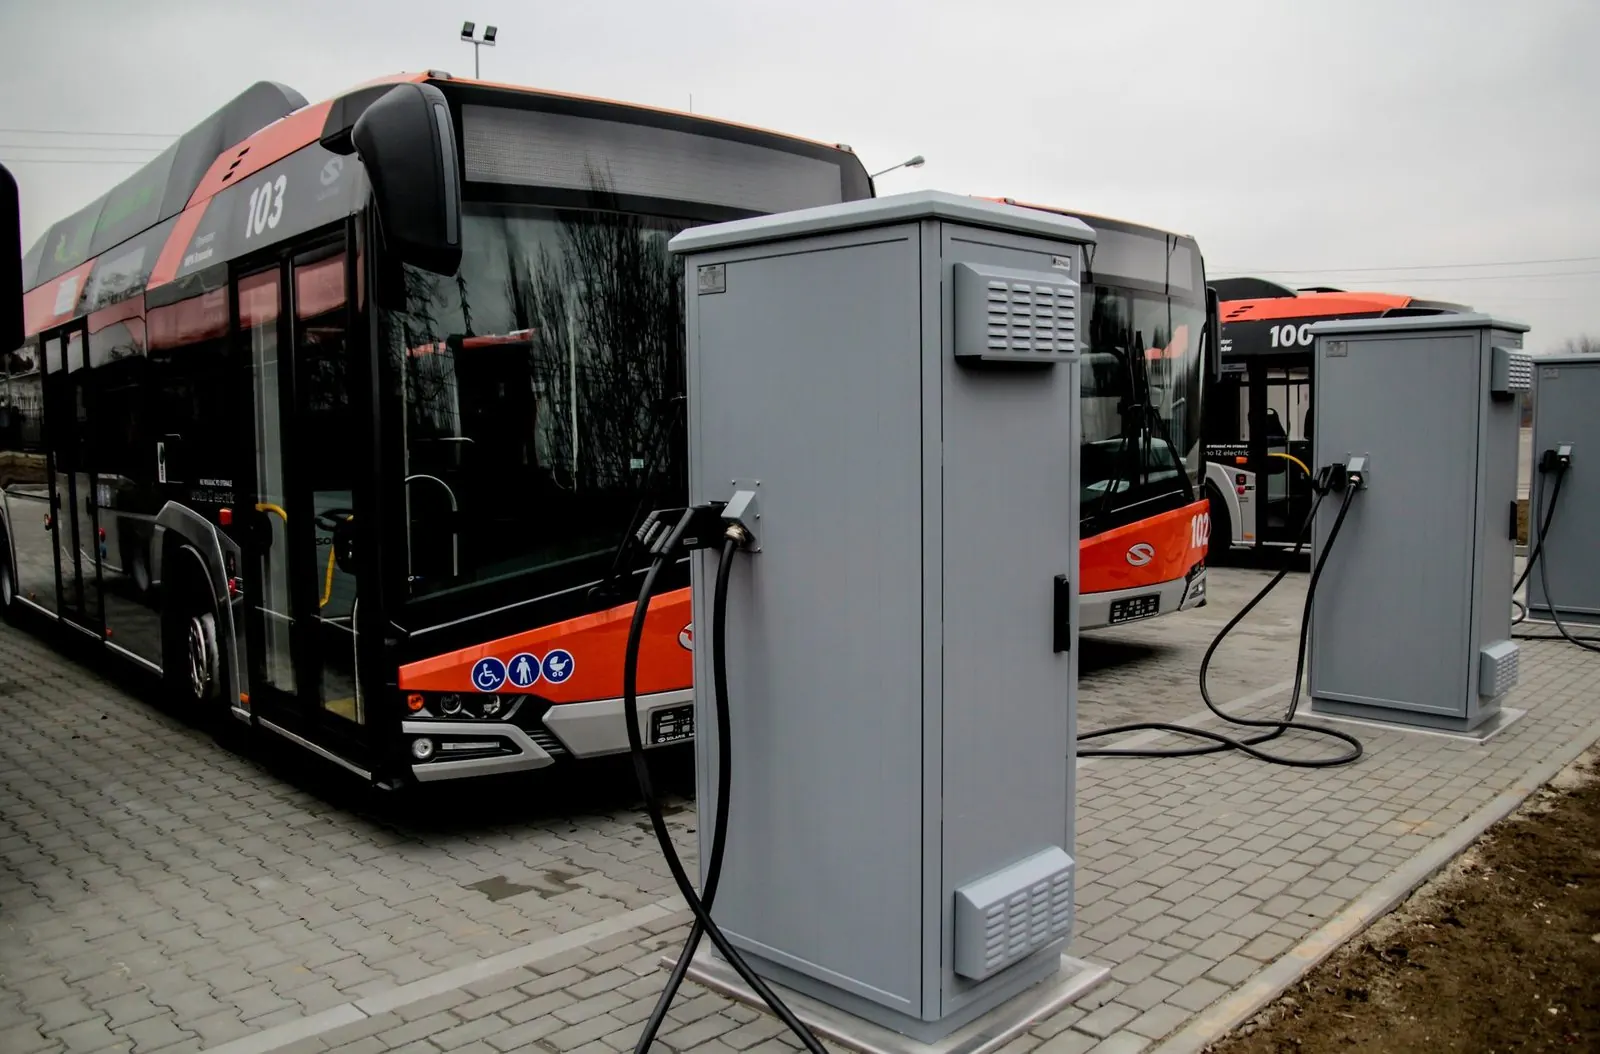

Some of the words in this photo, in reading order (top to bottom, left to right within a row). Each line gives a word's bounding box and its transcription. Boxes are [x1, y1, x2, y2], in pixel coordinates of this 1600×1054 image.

[245, 174, 287, 239] 103
[1270, 323, 1314, 348] 100
[1191, 511, 1209, 549] 102
